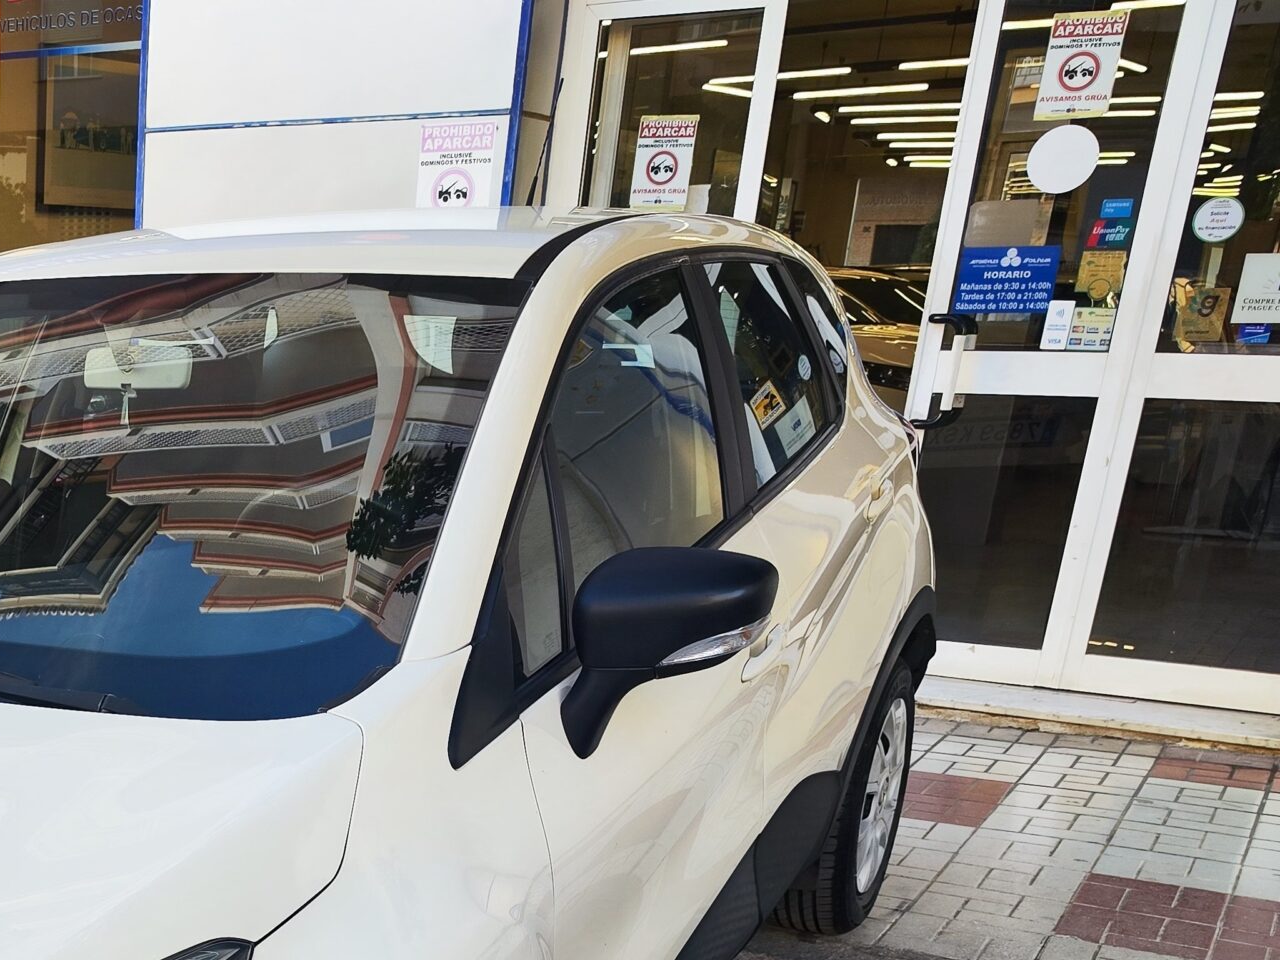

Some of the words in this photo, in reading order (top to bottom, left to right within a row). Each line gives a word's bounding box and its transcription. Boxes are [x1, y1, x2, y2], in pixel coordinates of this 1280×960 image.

[0, 11, 76, 34] VEHÍCULOS
[81, 9, 99, 26] DE
[1054, 23, 1123, 36] APARCAR
[1039, 95, 1082, 103] AVISAMOS
[642, 120, 696, 128] PROHIBIDO
[423, 123, 495, 139] PROHIBIDO
[641, 127, 695, 137] APARCAR
[423, 136, 493, 151] APARCAR
[440, 152, 473, 160] INCLUSIVE
[420, 158, 453, 166] DOMINGOS
[461, 157, 492, 165] FESTIVOS
[1093, 225, 1130, 237] UnionPay
[984, 270, 1031, 279] HORARIO
[960, 282, 992, 290] Mañanas
[993, 282, 1002, 290] de
[1004, 282, 1019, 290] 9:30
[1028, 282, 1051, 290] 14:00h
[997, 292, 1015, 300] 17:00
[955, 302, 985, 310] Sábados
[987, 302, 996, 310] de
